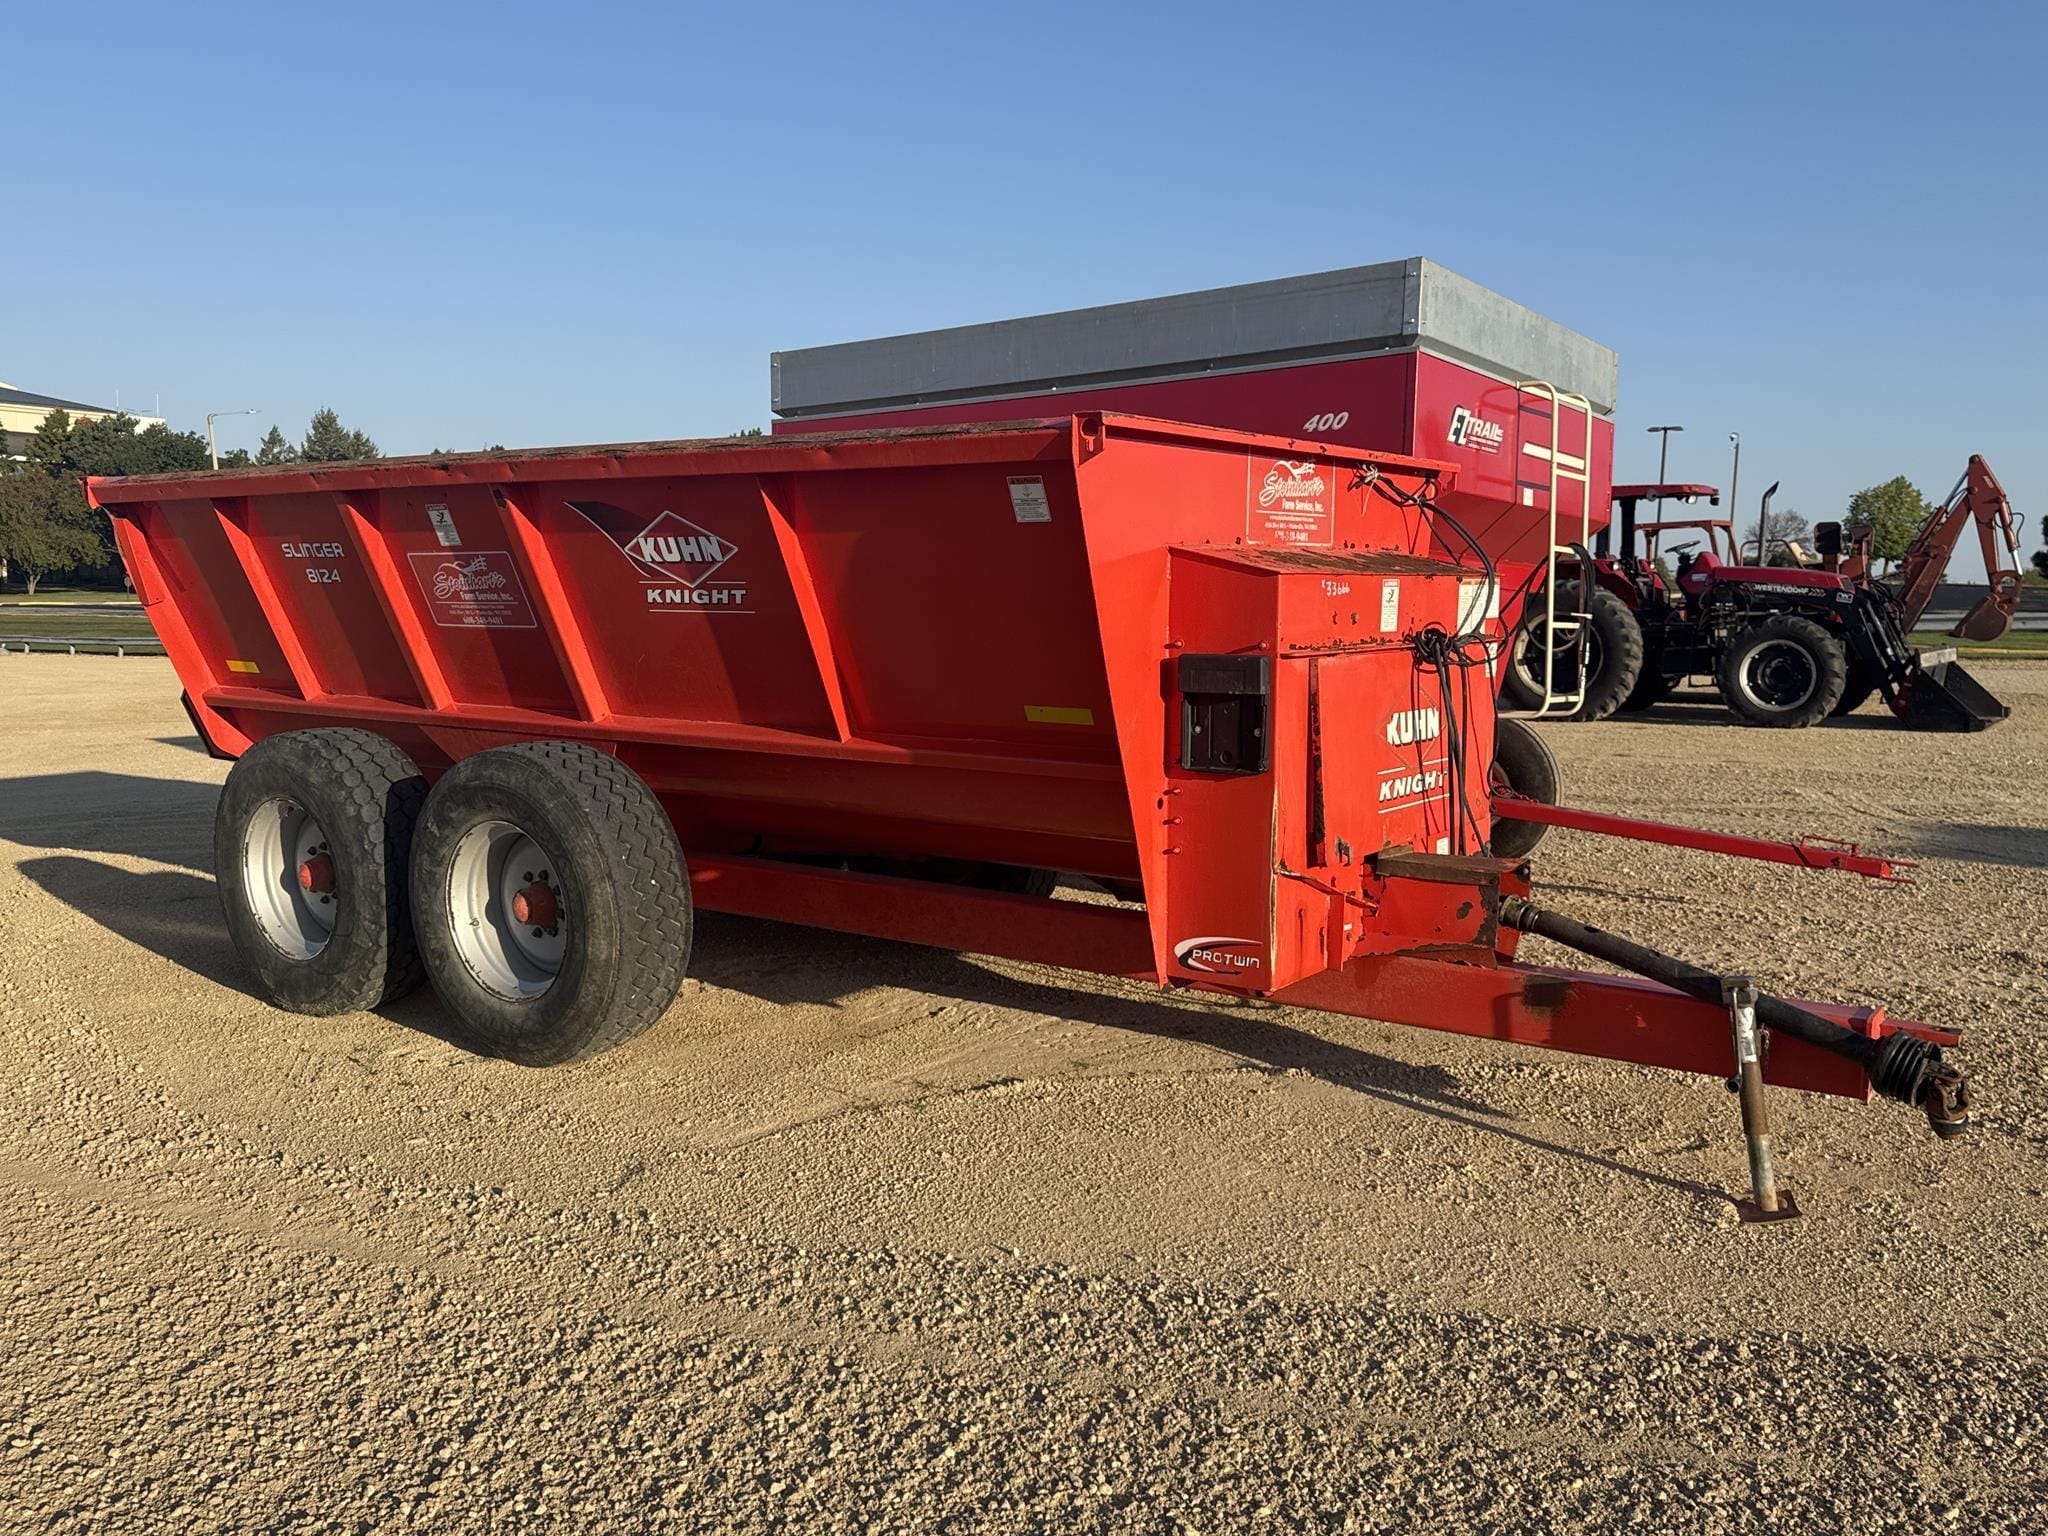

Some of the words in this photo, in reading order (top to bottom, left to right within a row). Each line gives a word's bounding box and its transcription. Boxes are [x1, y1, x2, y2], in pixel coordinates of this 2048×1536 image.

[1303, 411, 1349, 432] 400
[281, 543, 344, 558] SLINGER
[638, 536, 724, 562] KUHN
[306, 568, 341, 583] 8124
[646, 589, 746, 604] KNIGHT
[1754, 583, 1809, 594] WESTENDORF
[1386, 707, 1440, 747] KUHN
[1379, 770, 1448, 802] KNIGHT
[1192, 949, 1261, 969] PROTWIN
